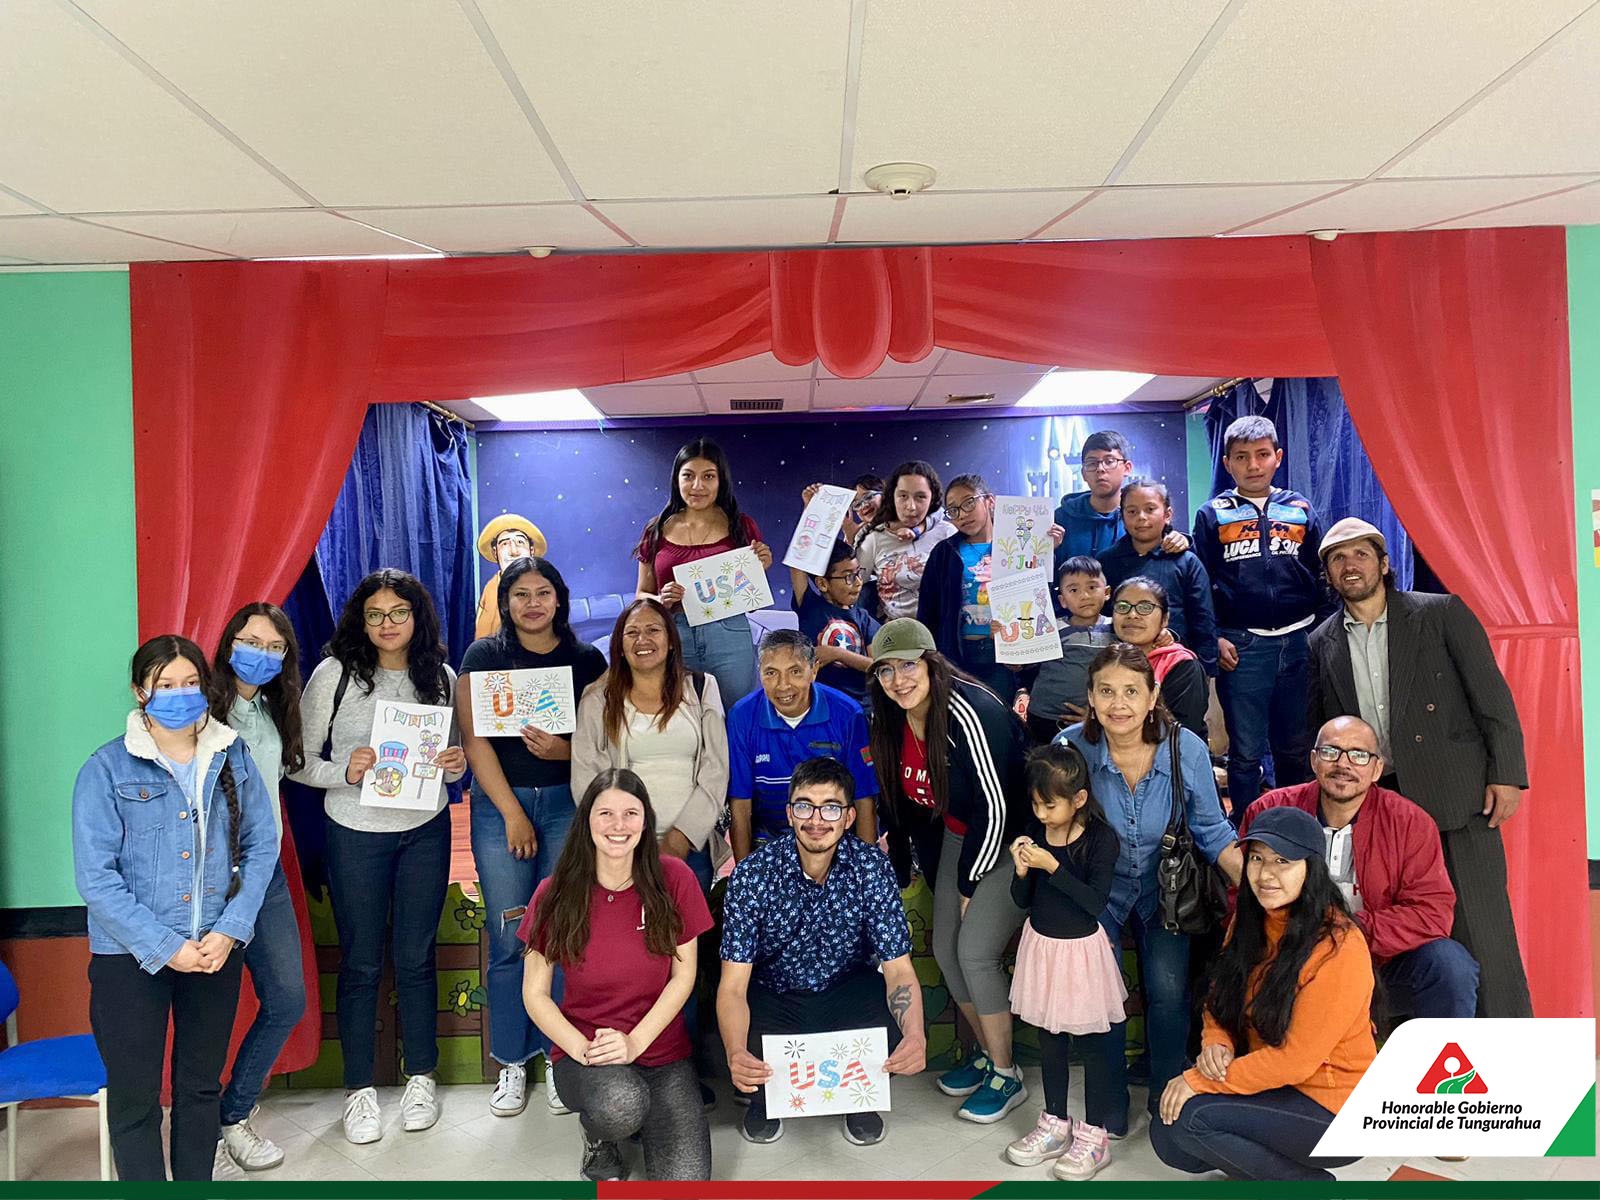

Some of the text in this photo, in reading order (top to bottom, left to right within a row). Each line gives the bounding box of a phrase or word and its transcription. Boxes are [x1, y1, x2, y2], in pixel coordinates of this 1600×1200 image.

[1001, 555, 1014, 570] of
[694, 566, 756, 604] USA
[1000, 613, 1055, 642] USA
[492, 689, 560, 718] USA
[789, 1058, 872, 1090] USA
